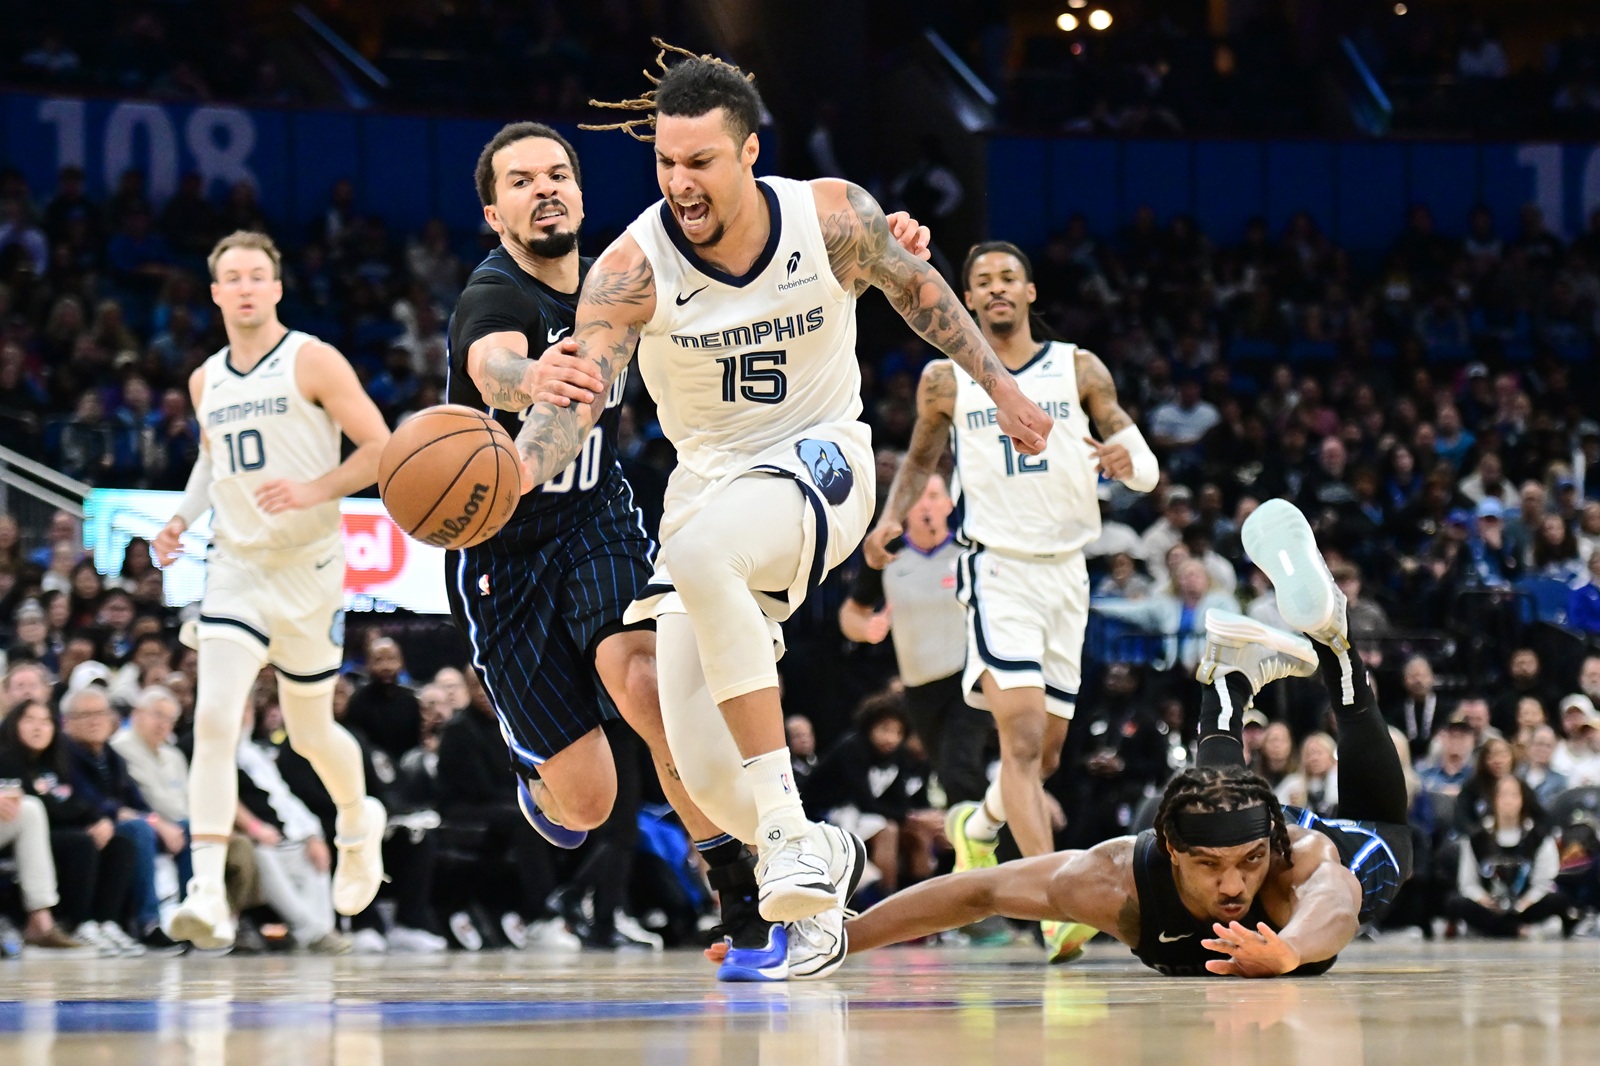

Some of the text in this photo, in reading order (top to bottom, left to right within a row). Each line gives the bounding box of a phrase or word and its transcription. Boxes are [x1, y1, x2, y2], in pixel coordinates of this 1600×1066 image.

[38, 98, 259, 206] 108
[777, 273, 819, 292] Robinhood
[670, 306, 824, 349] MEMPHIS
[715, 349, 787, 405] 15
[207, 397, 288, 426] MEMPHIS
[966, 401, 1071, 430] MEHIS
[224, 428, 266, 475] 10
[425, 482, 490, 546] Wilson
